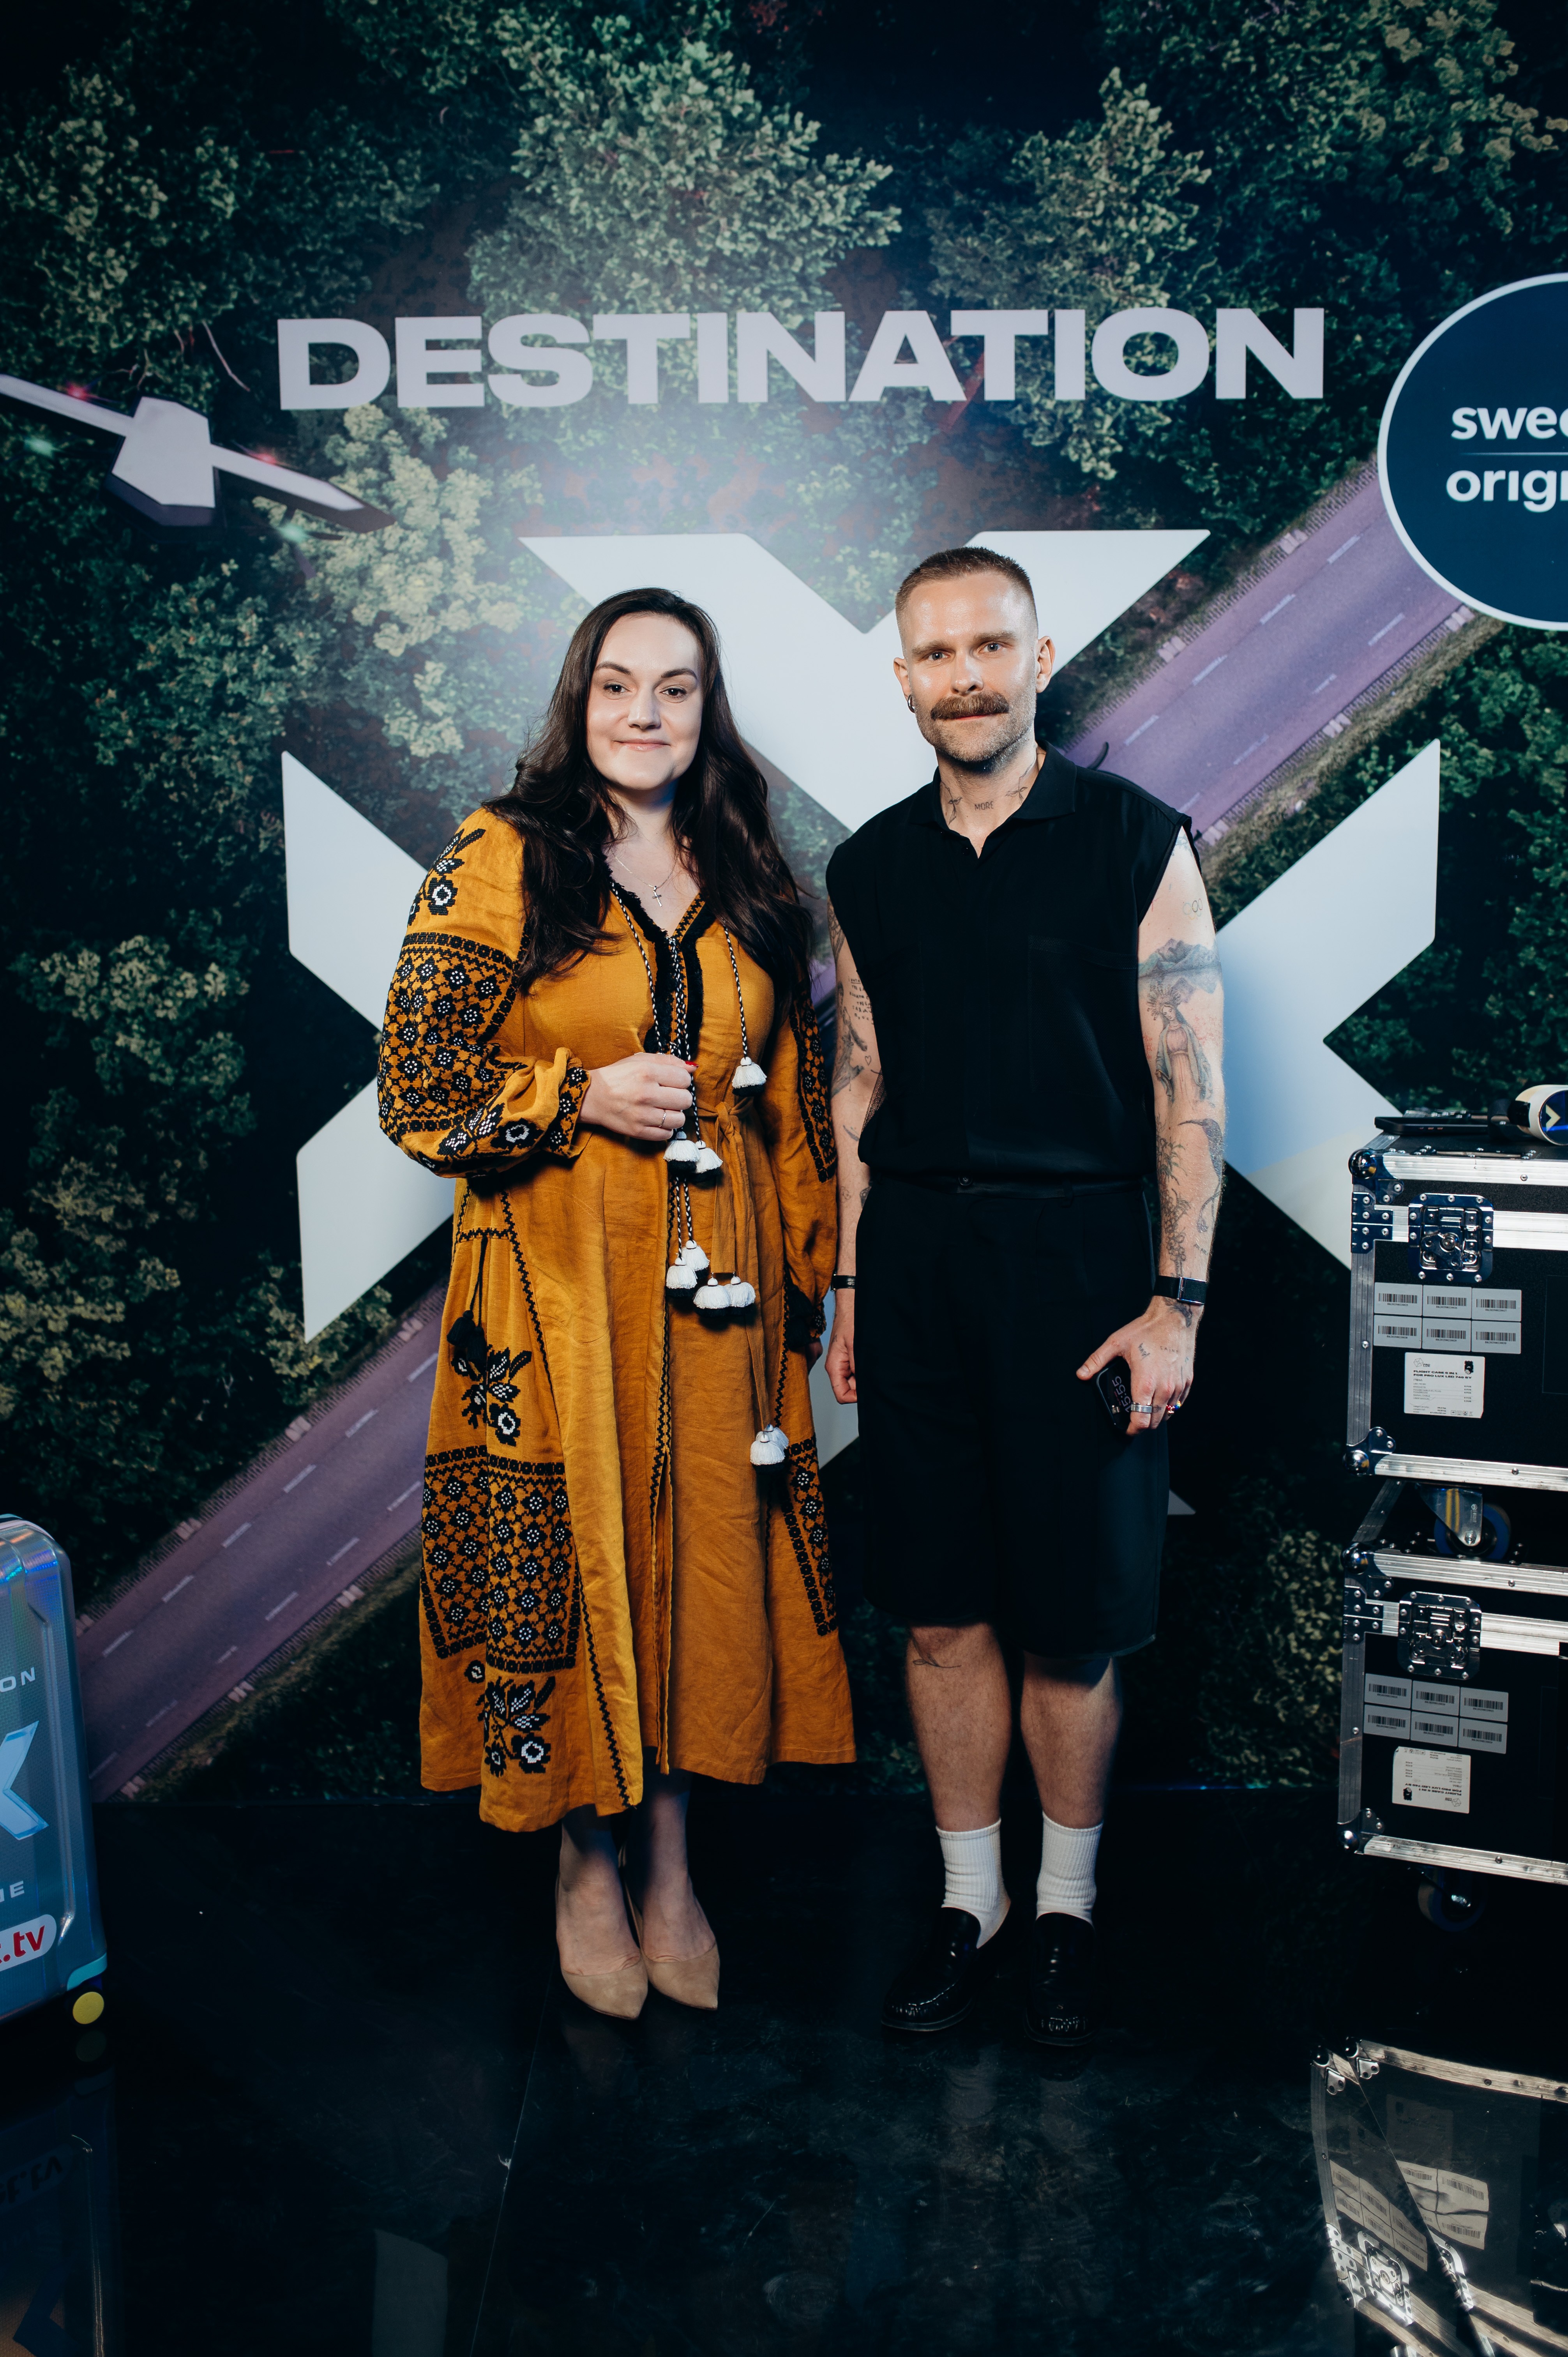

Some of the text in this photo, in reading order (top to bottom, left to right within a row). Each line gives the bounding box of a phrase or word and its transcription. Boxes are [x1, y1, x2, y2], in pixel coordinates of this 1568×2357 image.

[277, 307, 1325, 411] DESTINATION
[1451, 406, 1568, 440] swe
[975, 801, 993, 811] MORE
[1112, 1376, 1131, 1413] 15:55
[0, 1925, 45, 1964] .tv
